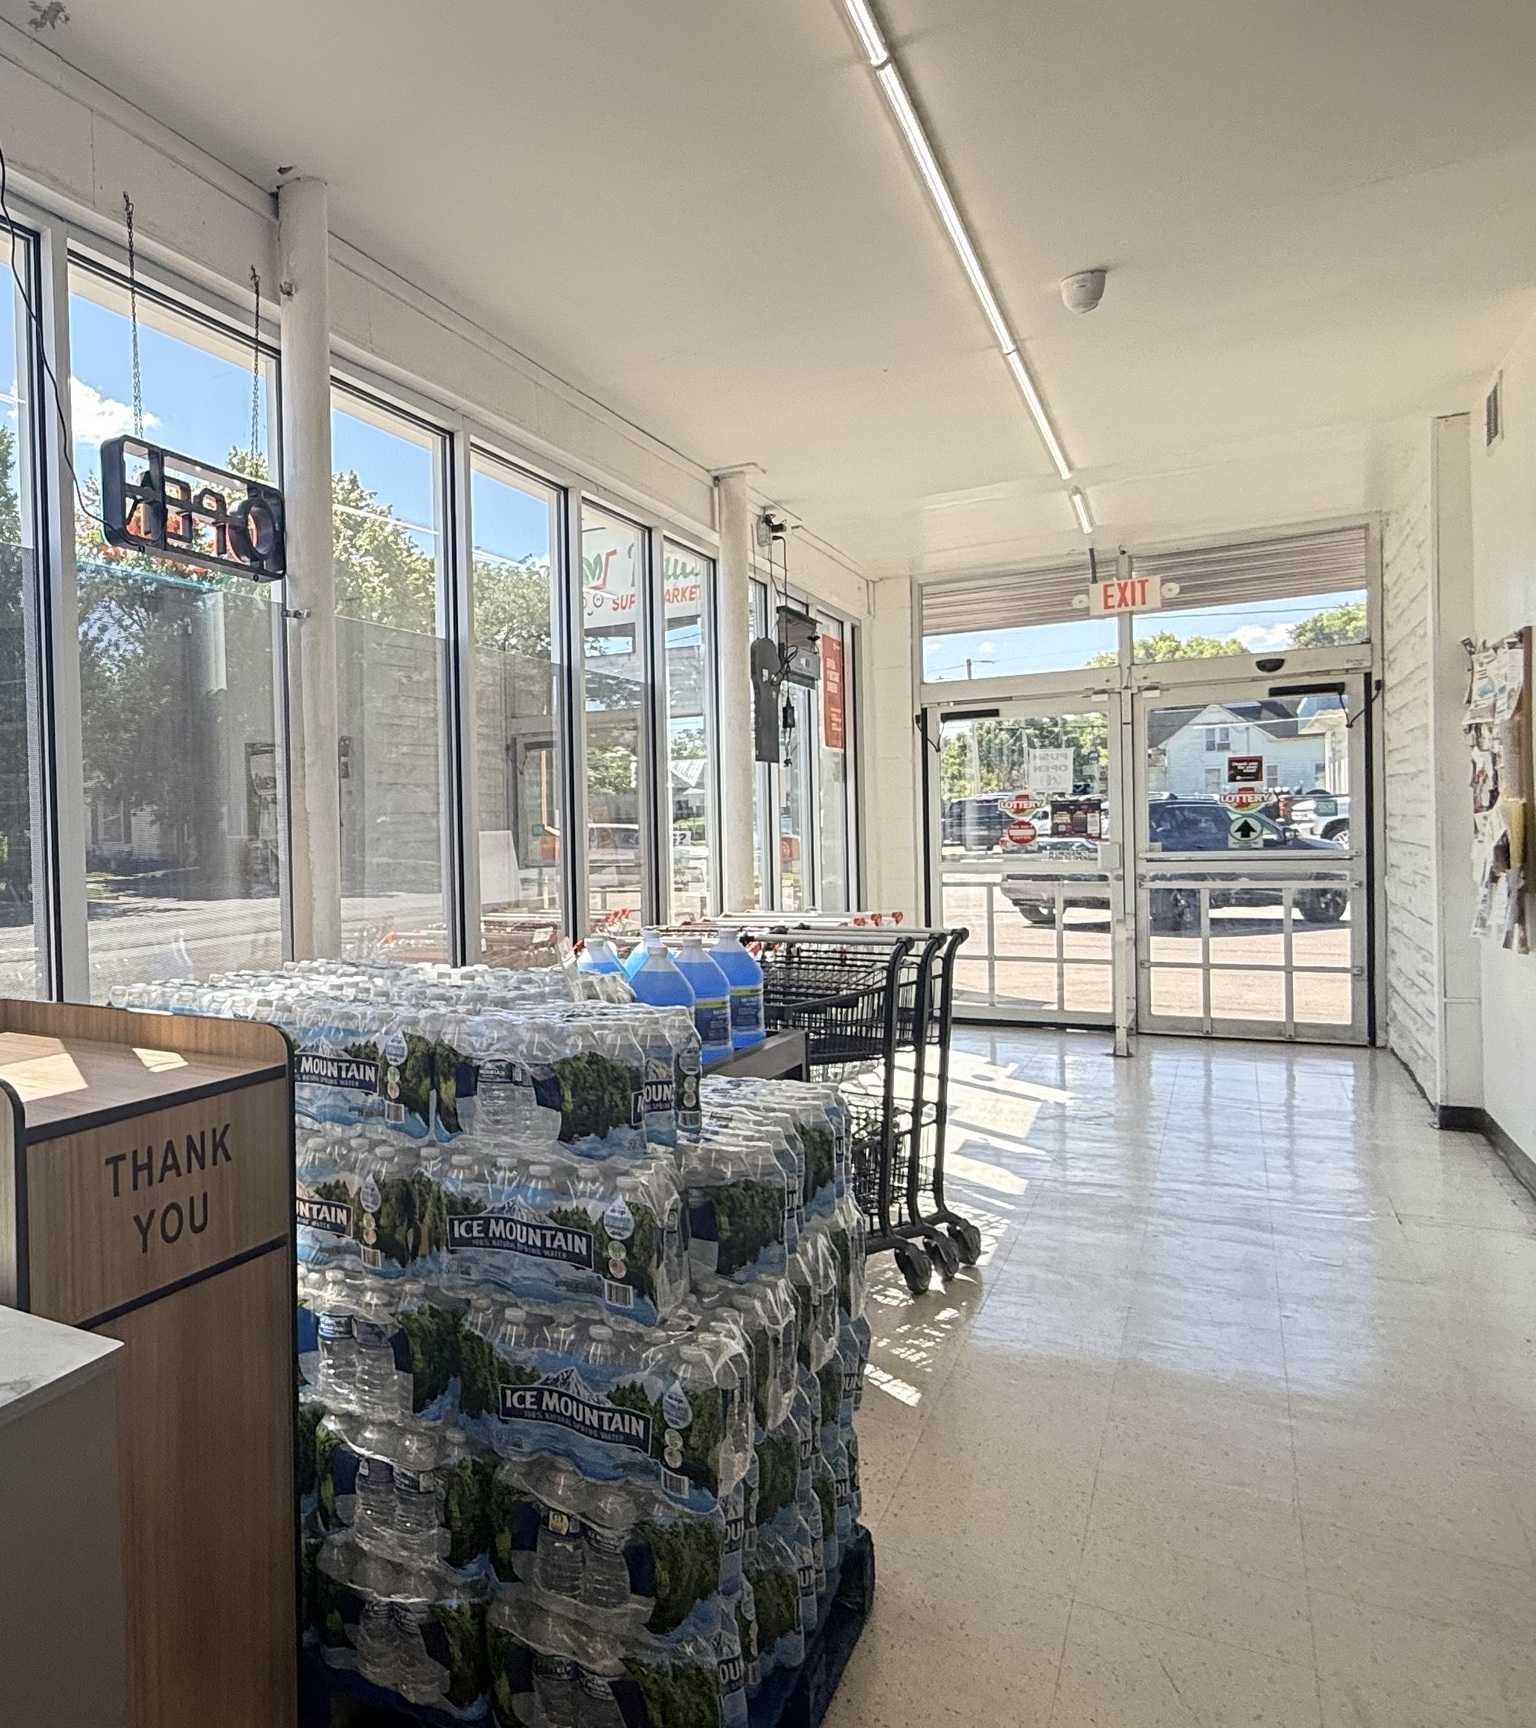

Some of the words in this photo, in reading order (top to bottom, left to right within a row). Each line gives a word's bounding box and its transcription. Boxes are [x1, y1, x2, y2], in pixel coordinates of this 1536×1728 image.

[1103, 579, 1149, 609] EXIT
[1000, 800, 1043, 809] LOTTERY
[1220, 793, 1271, 804] LOTTERY
[300, 1056, 375, 1082] MOUNTAIN
[105, 1123, 232, 1197] THANK
[133, 1191, 208, 1253] YOU
[297, 1200, 347, 1225] NTAIN
[453, 1220, 485, 1239] ICE
[488, 1218, 587, 1256] MOUNTAIN
[506, 1389, 538, 1409] ICE
[541, 1390, 645, 1440] MOUNTAIN
